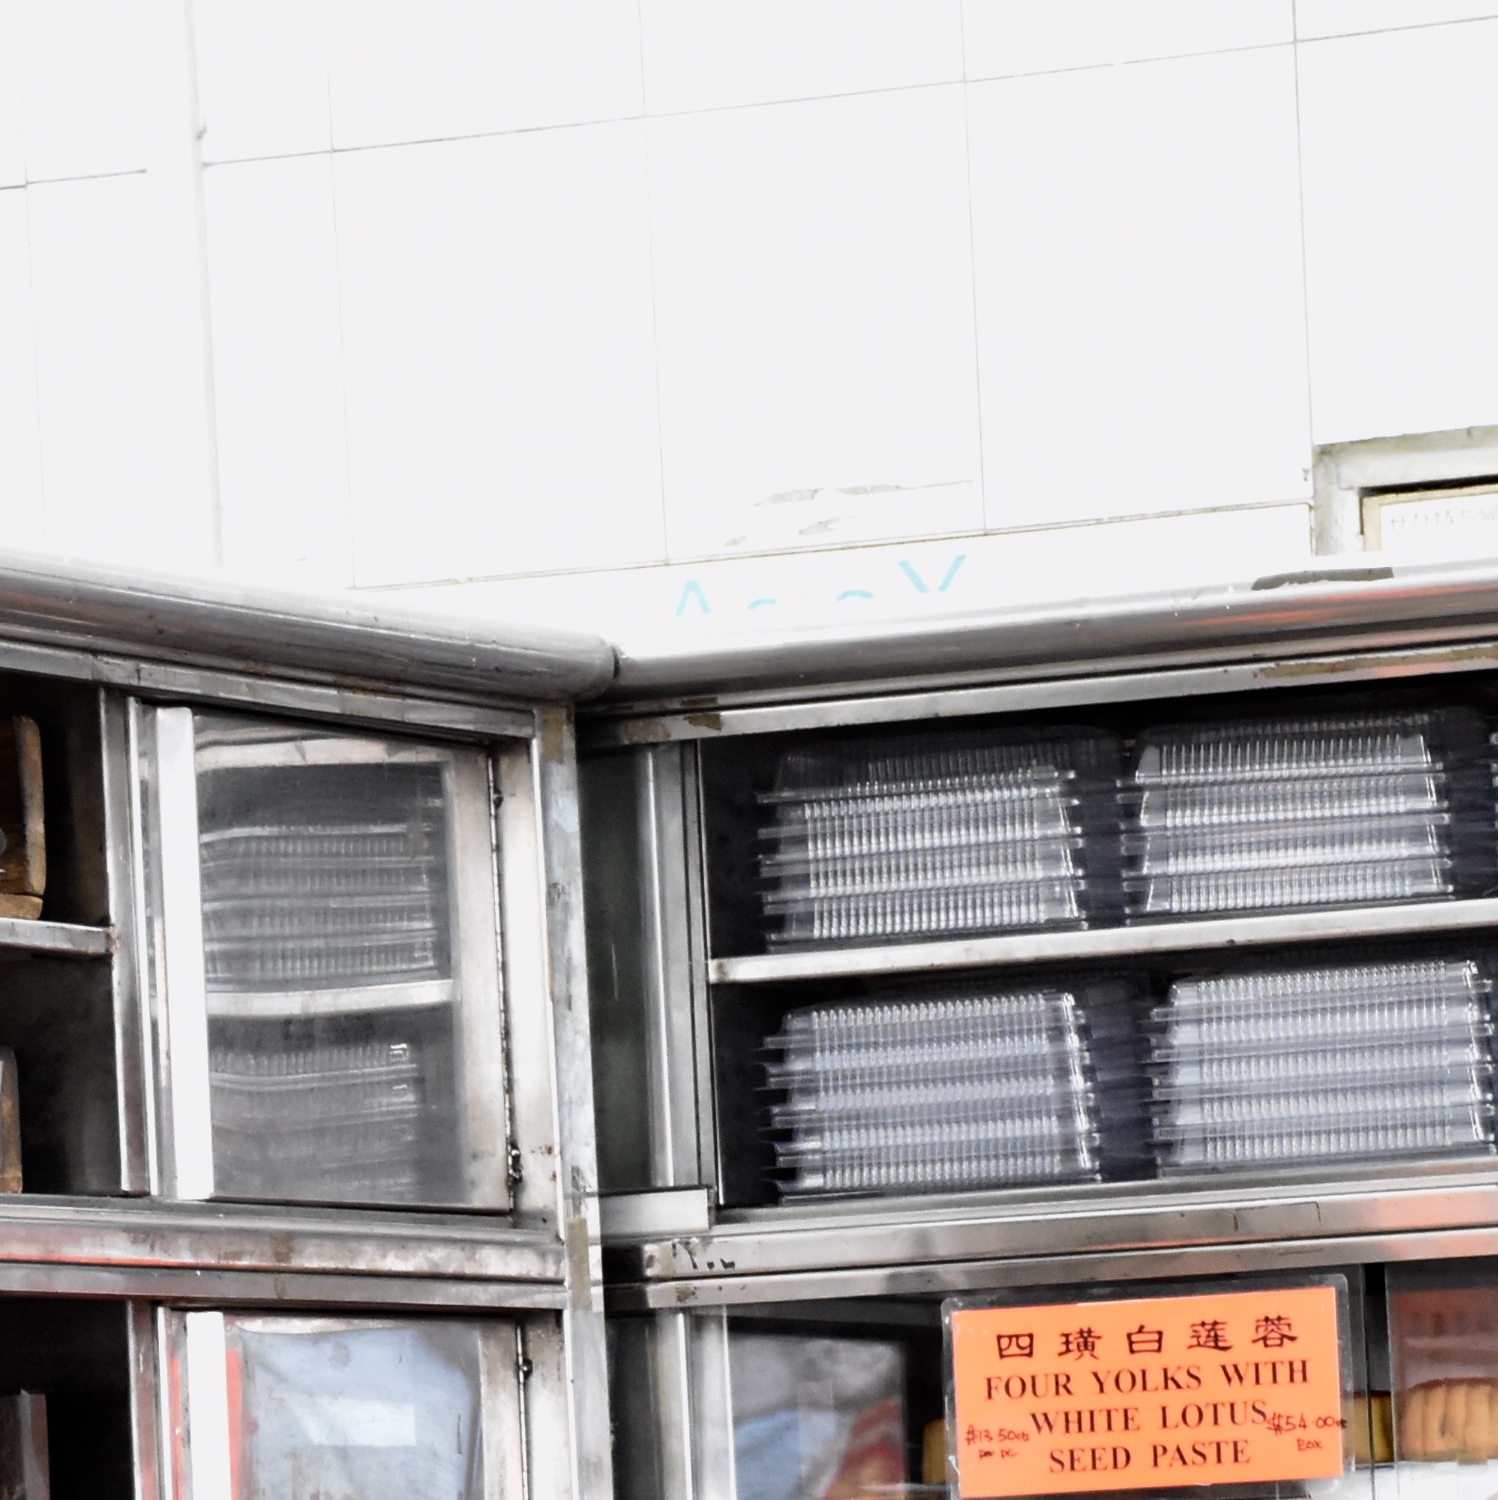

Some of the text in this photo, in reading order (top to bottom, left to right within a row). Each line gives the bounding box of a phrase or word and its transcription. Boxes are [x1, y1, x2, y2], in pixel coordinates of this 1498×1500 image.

[985, 1359, 1310, 1400] FOUR YOLKS WITH
[1030, 1400, 1268, 1435] WHITE LOTUS
[1049, 1439, 1251, 1473] SEED PASTE
